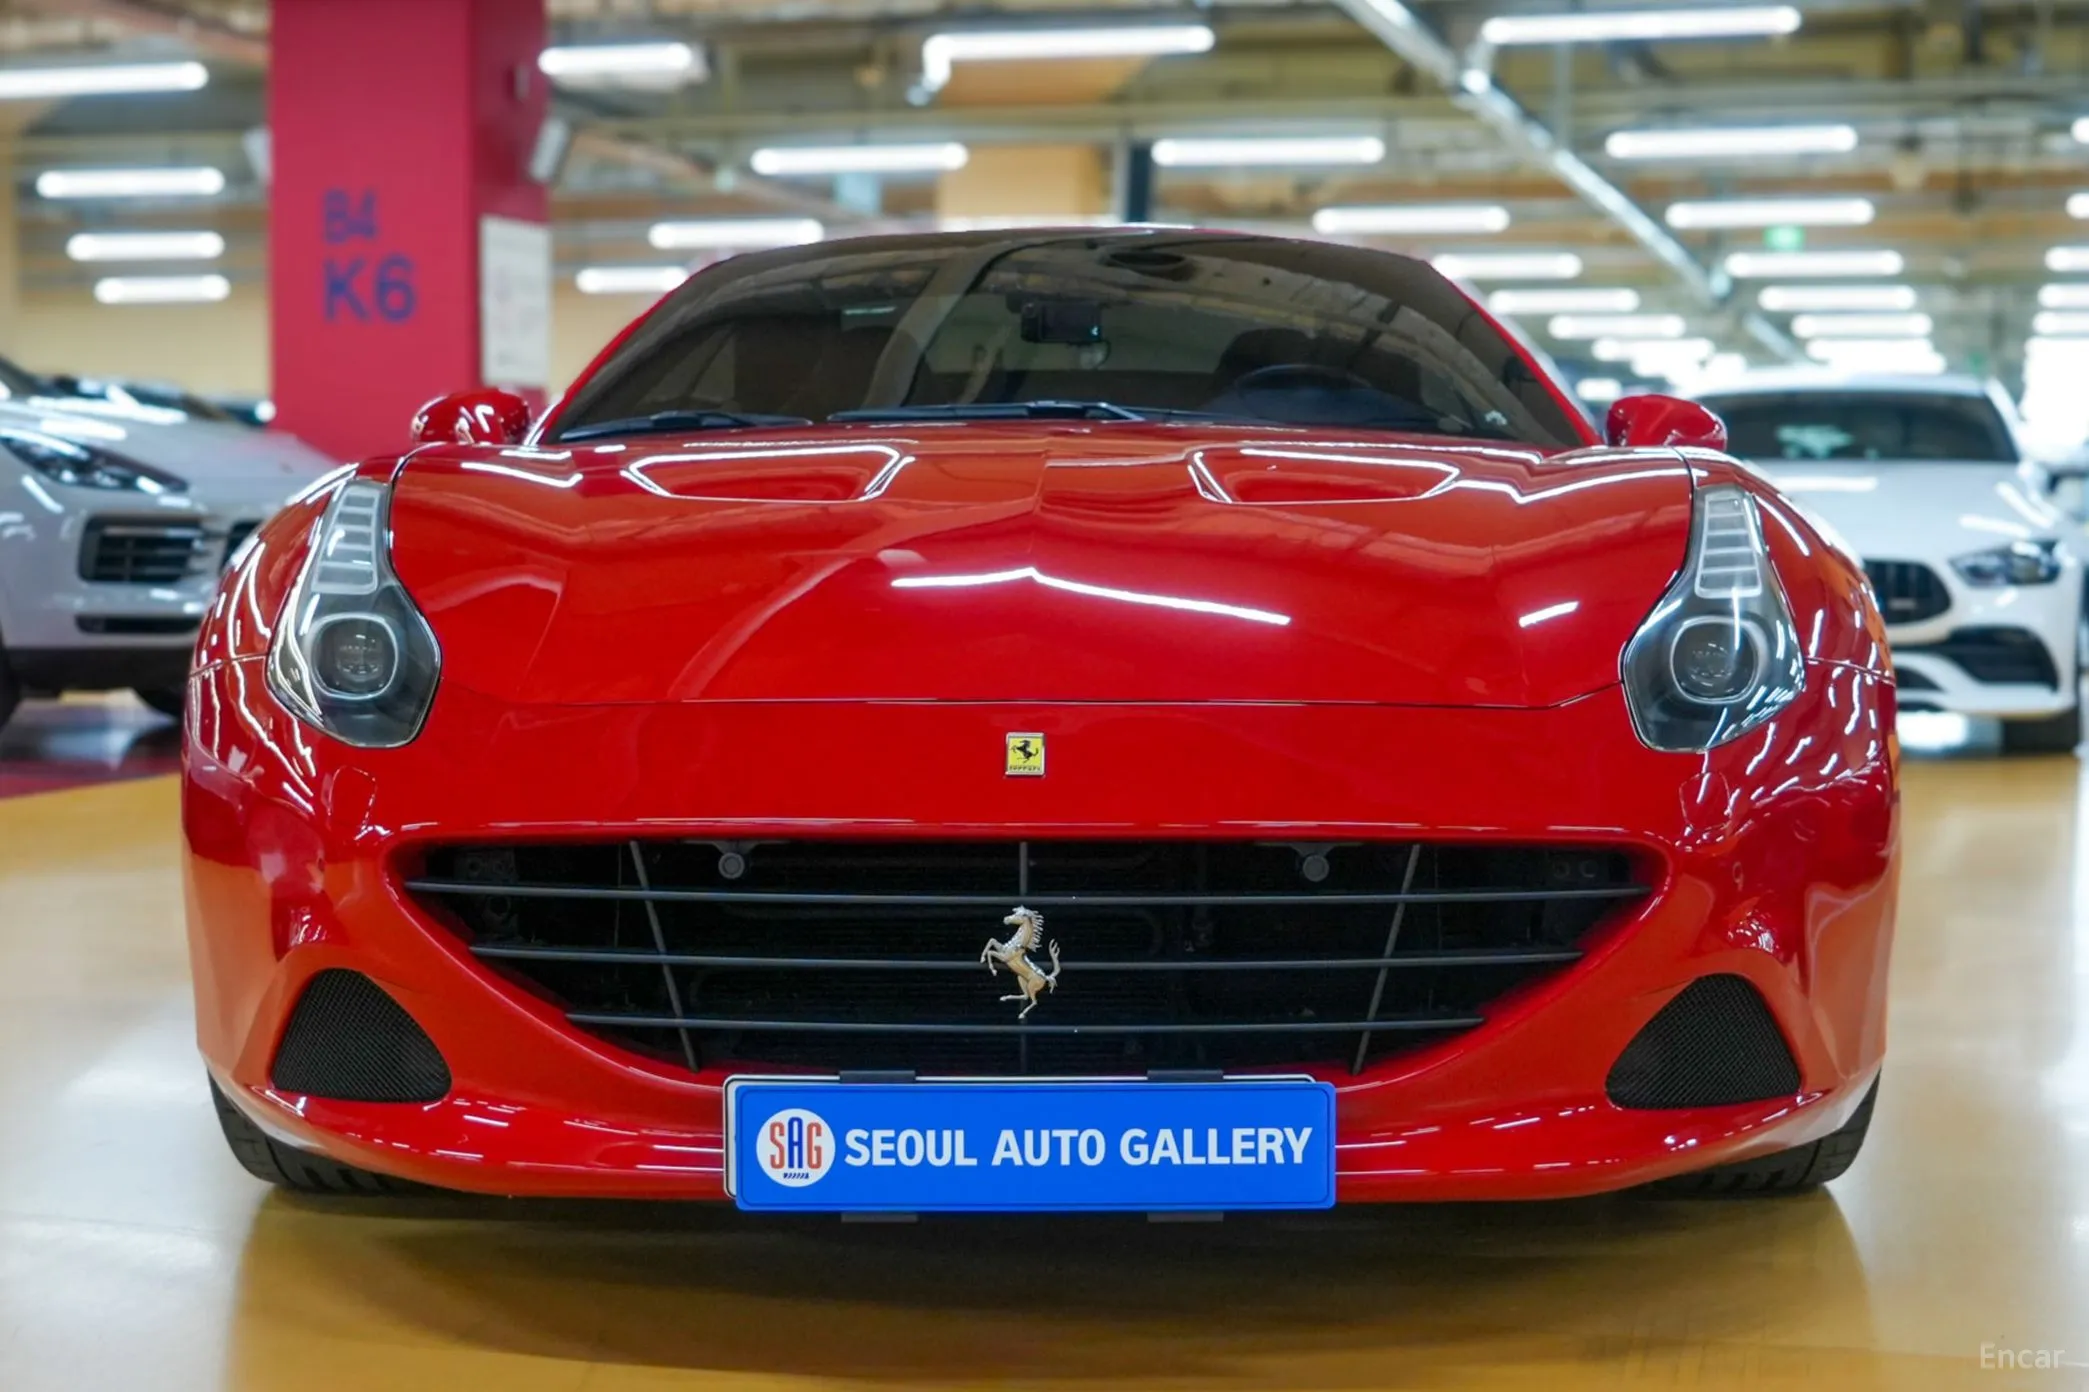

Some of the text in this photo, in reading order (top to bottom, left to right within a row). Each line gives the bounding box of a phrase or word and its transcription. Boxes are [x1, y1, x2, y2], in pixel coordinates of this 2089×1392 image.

[323, 188, 377, 245] B4
[323, 253, 418, 323] K6
[769, 1116, 823, 1170] SAG
[845, 1127, 1313, 1167] SEOUL AUTO GALLERY
